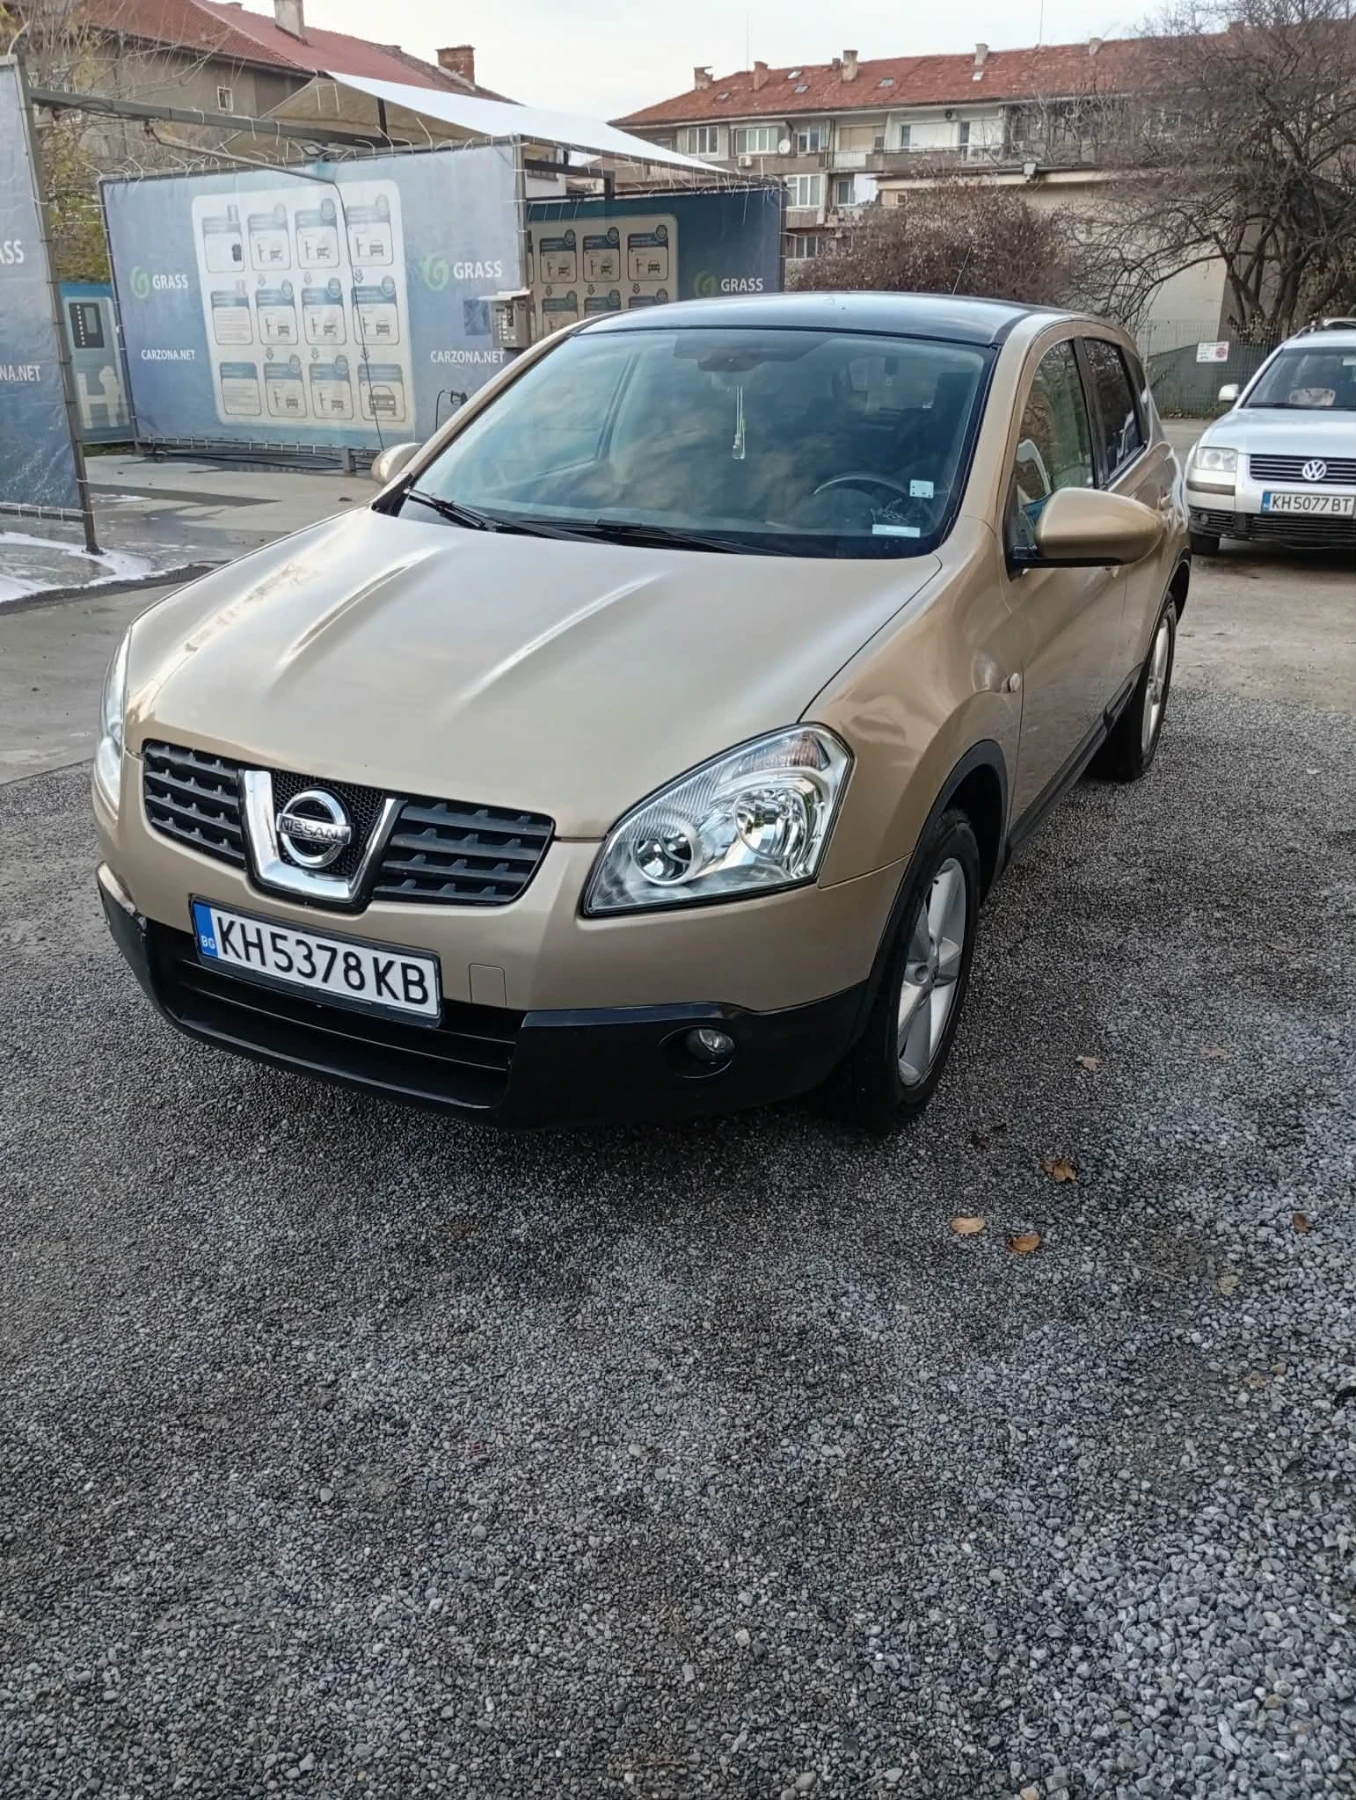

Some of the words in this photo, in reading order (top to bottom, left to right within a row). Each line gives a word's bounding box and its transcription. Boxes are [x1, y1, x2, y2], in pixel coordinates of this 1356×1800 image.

[453, 260, 502, 280] GRASS
[152, 273, 189, 290] GRASS
[720, 277, 764, 292] GRASS
[141, 348, 196, 361] CARZONA.NET
[430, 350, 505, 364] CARZONA.NET
[281, 818, 339, 840] NISSAN
[201, 934, 216, 950] BG
